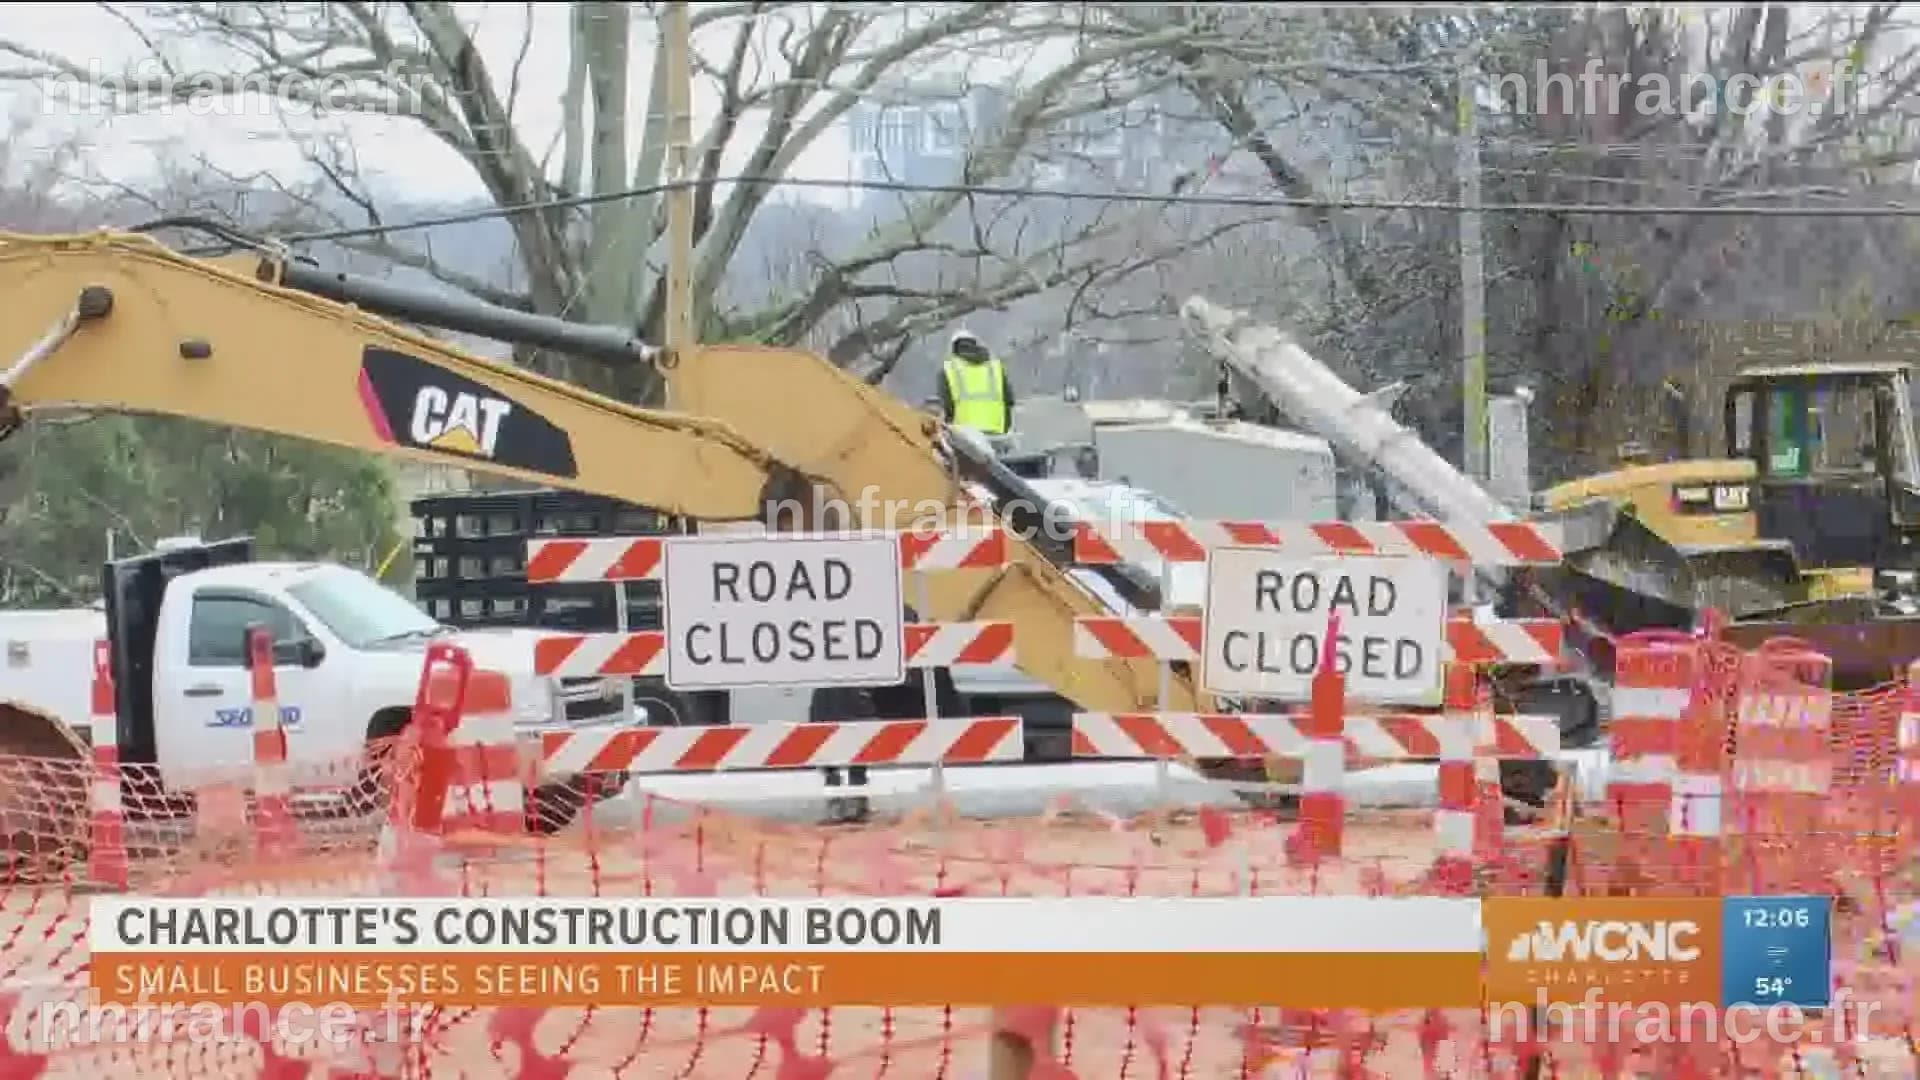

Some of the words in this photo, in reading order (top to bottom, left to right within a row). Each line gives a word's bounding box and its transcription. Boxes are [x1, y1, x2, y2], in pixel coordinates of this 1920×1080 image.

[411, 385, 511, 458] CAT
[712, 558, 852, 603] ROAD
[1255, 569, 1397, 617] ROAD
[685, 619, 884, 665] CLOSED
